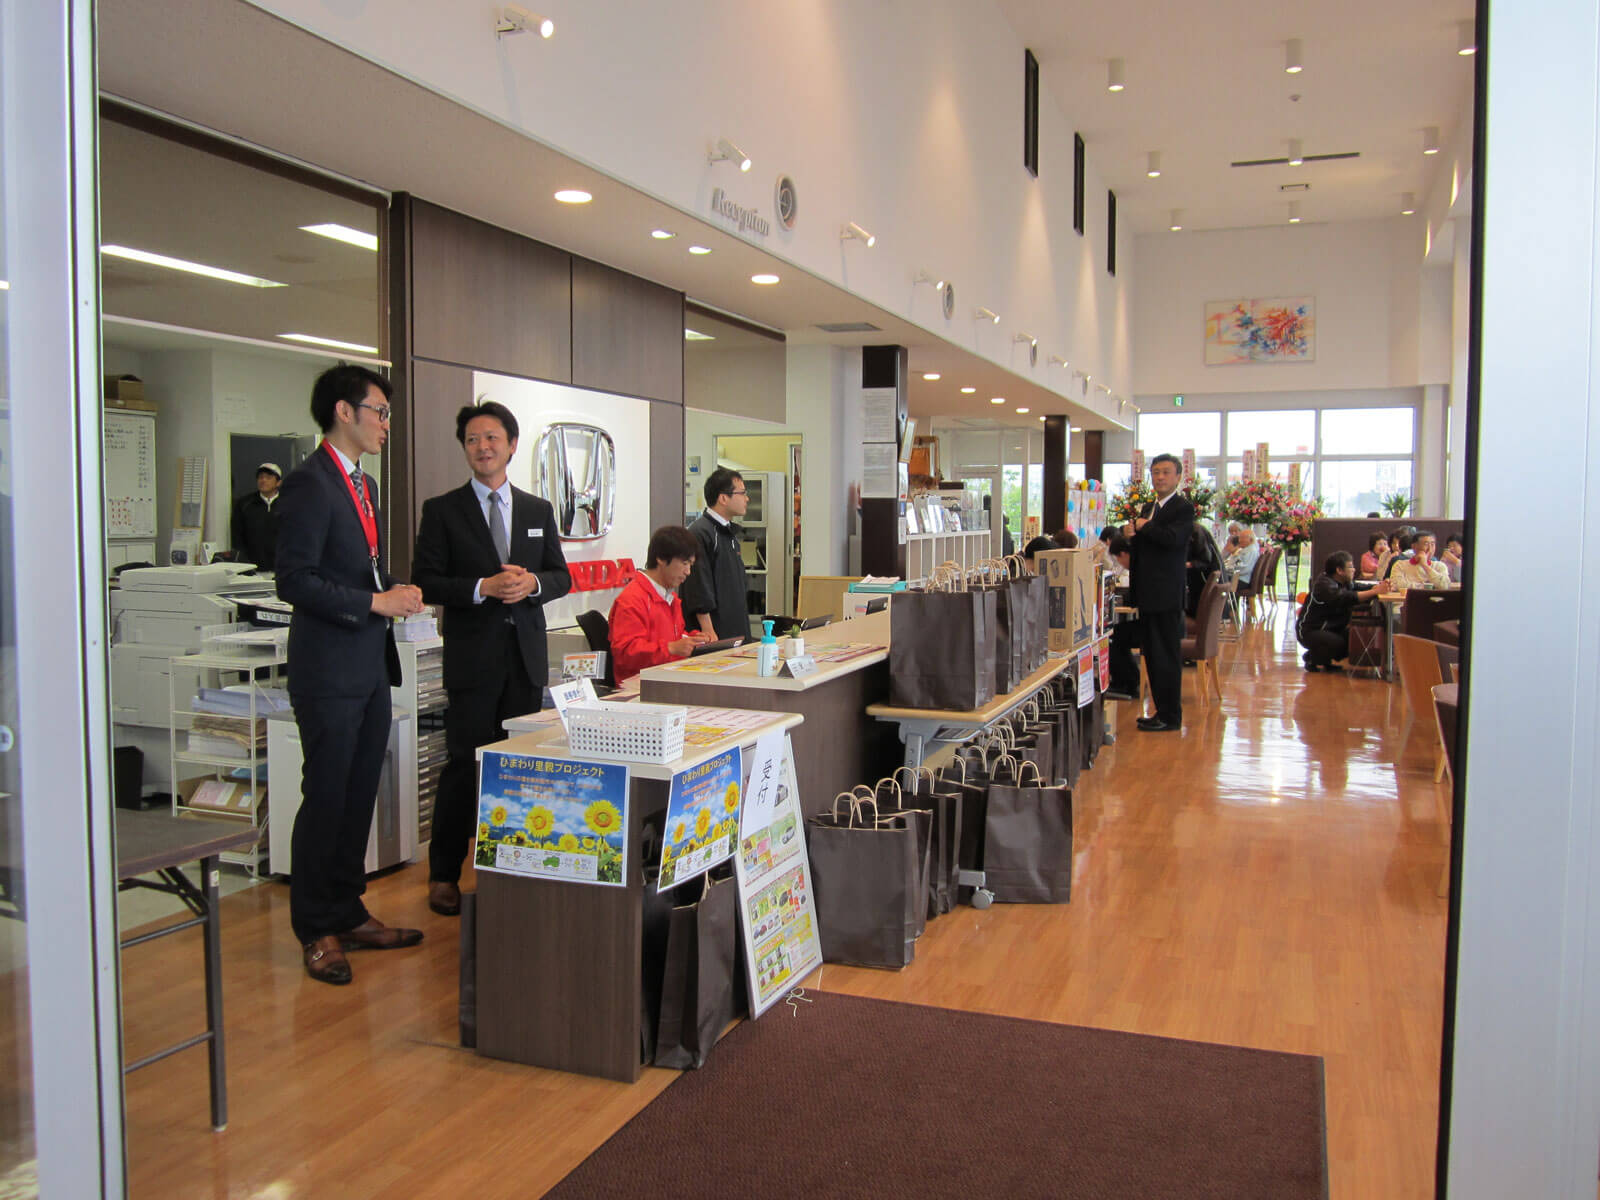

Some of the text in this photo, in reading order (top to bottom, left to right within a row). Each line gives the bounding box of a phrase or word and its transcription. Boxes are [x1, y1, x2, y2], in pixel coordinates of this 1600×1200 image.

[712, 188, 769, 236] Reception
[567, 558, 635, 594] NDA
[500, 757, 605, 778] ひまわり里親プロジェクト
[683, 755, 731, 784] ひまわり里親プロジェクト
[757, 759, 772, 806] 受付
